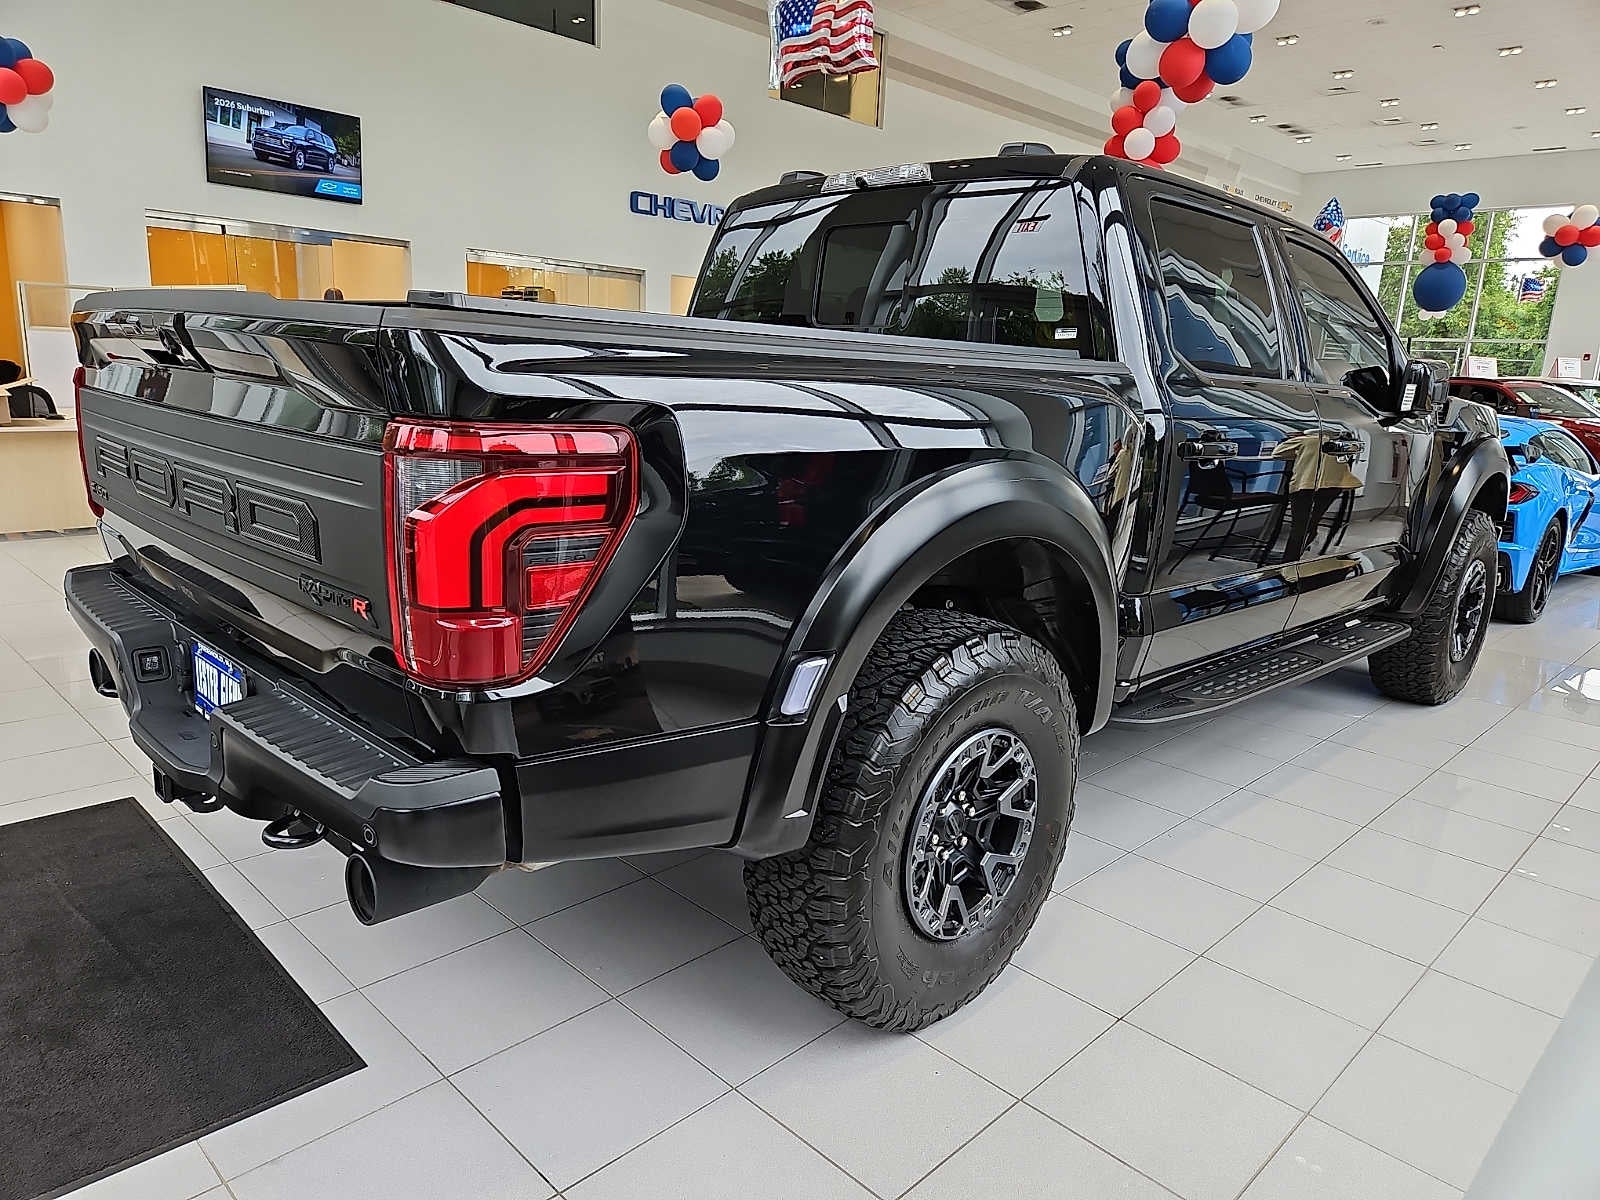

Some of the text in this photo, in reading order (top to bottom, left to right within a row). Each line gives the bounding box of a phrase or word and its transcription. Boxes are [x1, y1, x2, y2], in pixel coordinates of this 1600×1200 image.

[214, 97, 275, 118] 2026 Suburban
[94, 433, 323, 565] FORD
[298, 574, 372, 622] RAPTOR
